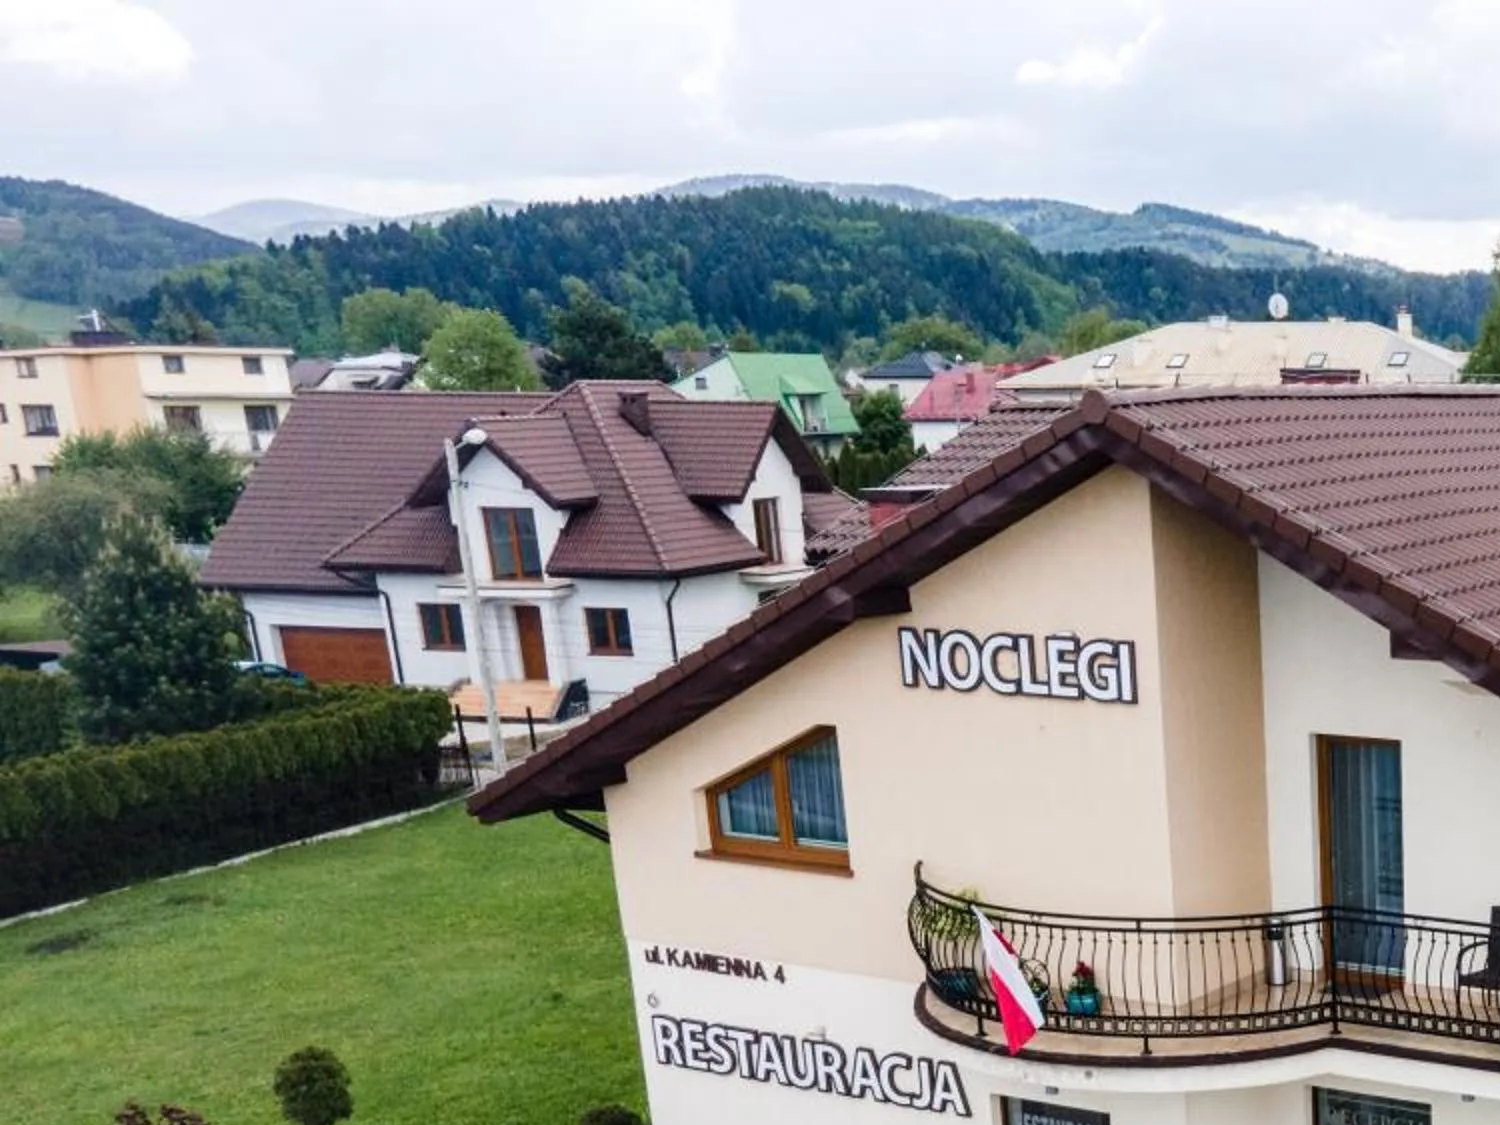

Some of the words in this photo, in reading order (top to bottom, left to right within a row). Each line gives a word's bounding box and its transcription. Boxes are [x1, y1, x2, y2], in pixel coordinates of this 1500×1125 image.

[898, 626, 1138, 704] NOCLEGI
[665, 947, 768, 982] KAMIENNA
[773, 964, 786, 984] 4
[651, 1014, 972, 1117] RESTAURACJA
